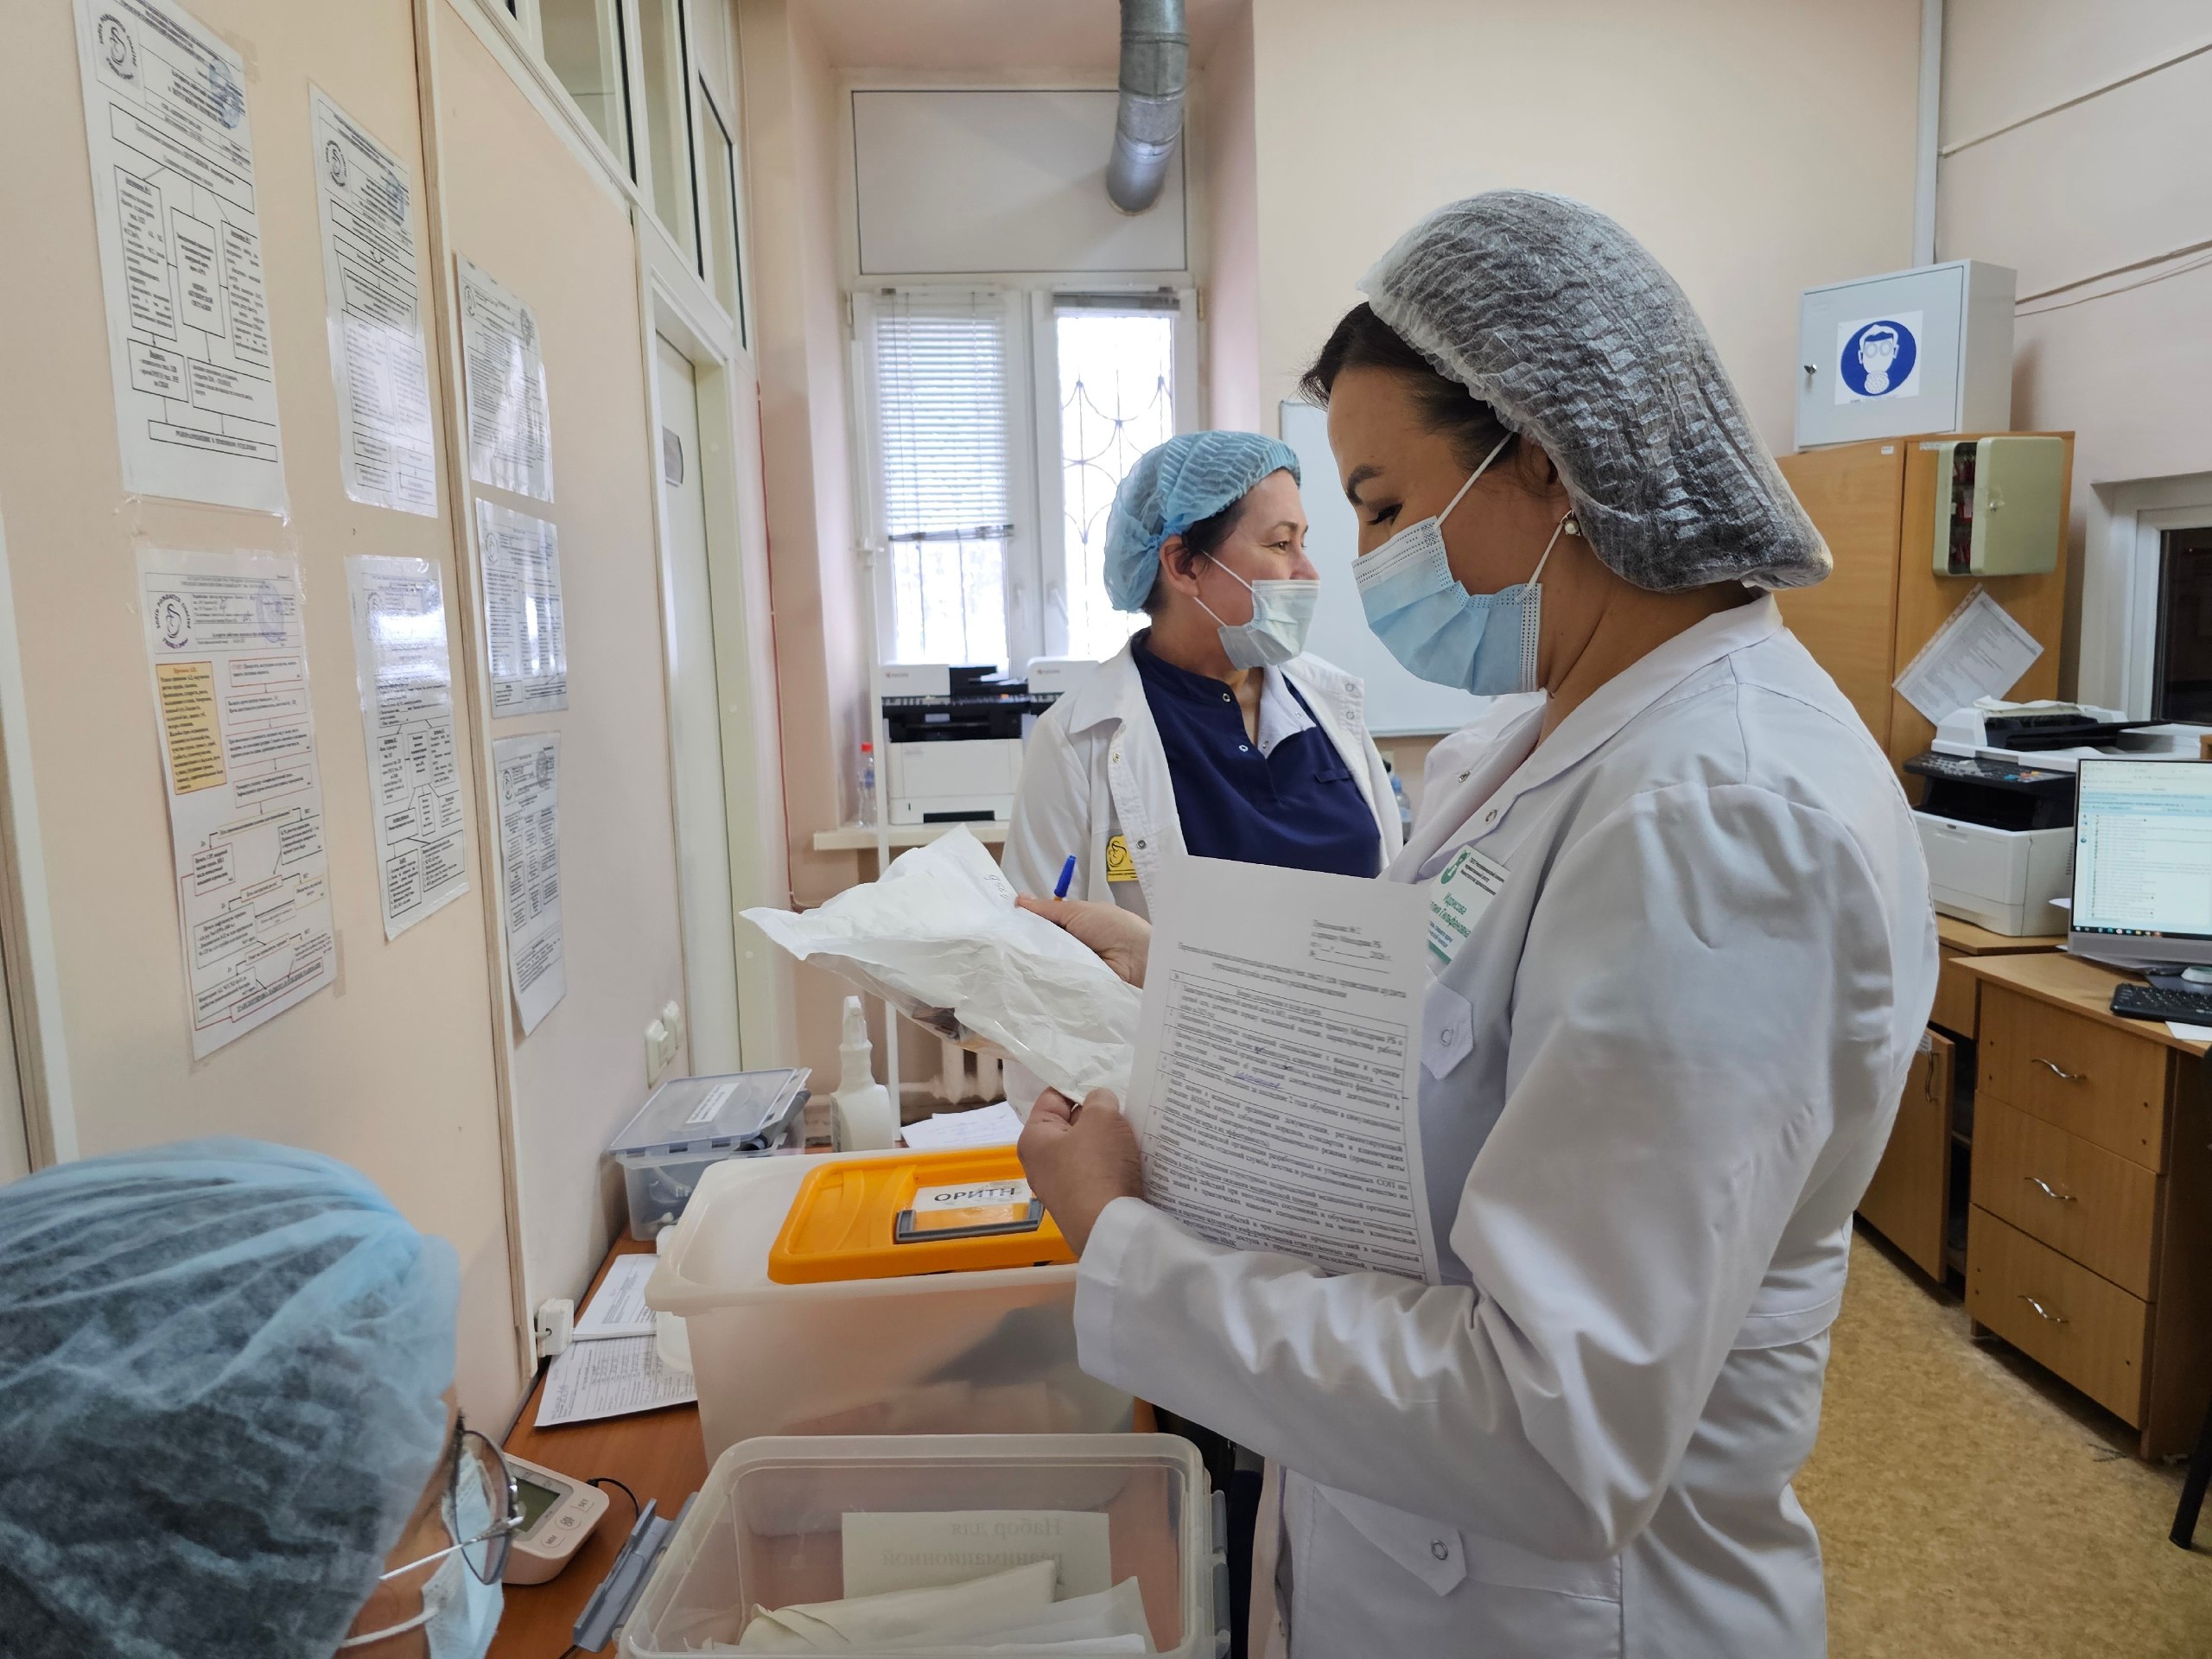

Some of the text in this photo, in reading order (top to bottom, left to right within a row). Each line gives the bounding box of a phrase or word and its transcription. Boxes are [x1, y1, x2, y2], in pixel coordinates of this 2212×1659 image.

[1371, 1066, 1400, 1078] средним
[1308, 1103, 1338, 1116] обучение
[1376, 1177, 1395, 1189] СОП
[933, 1187, 1015, 1202] ОРИТН
[1327, 1211, 1361, 1226] обучение
